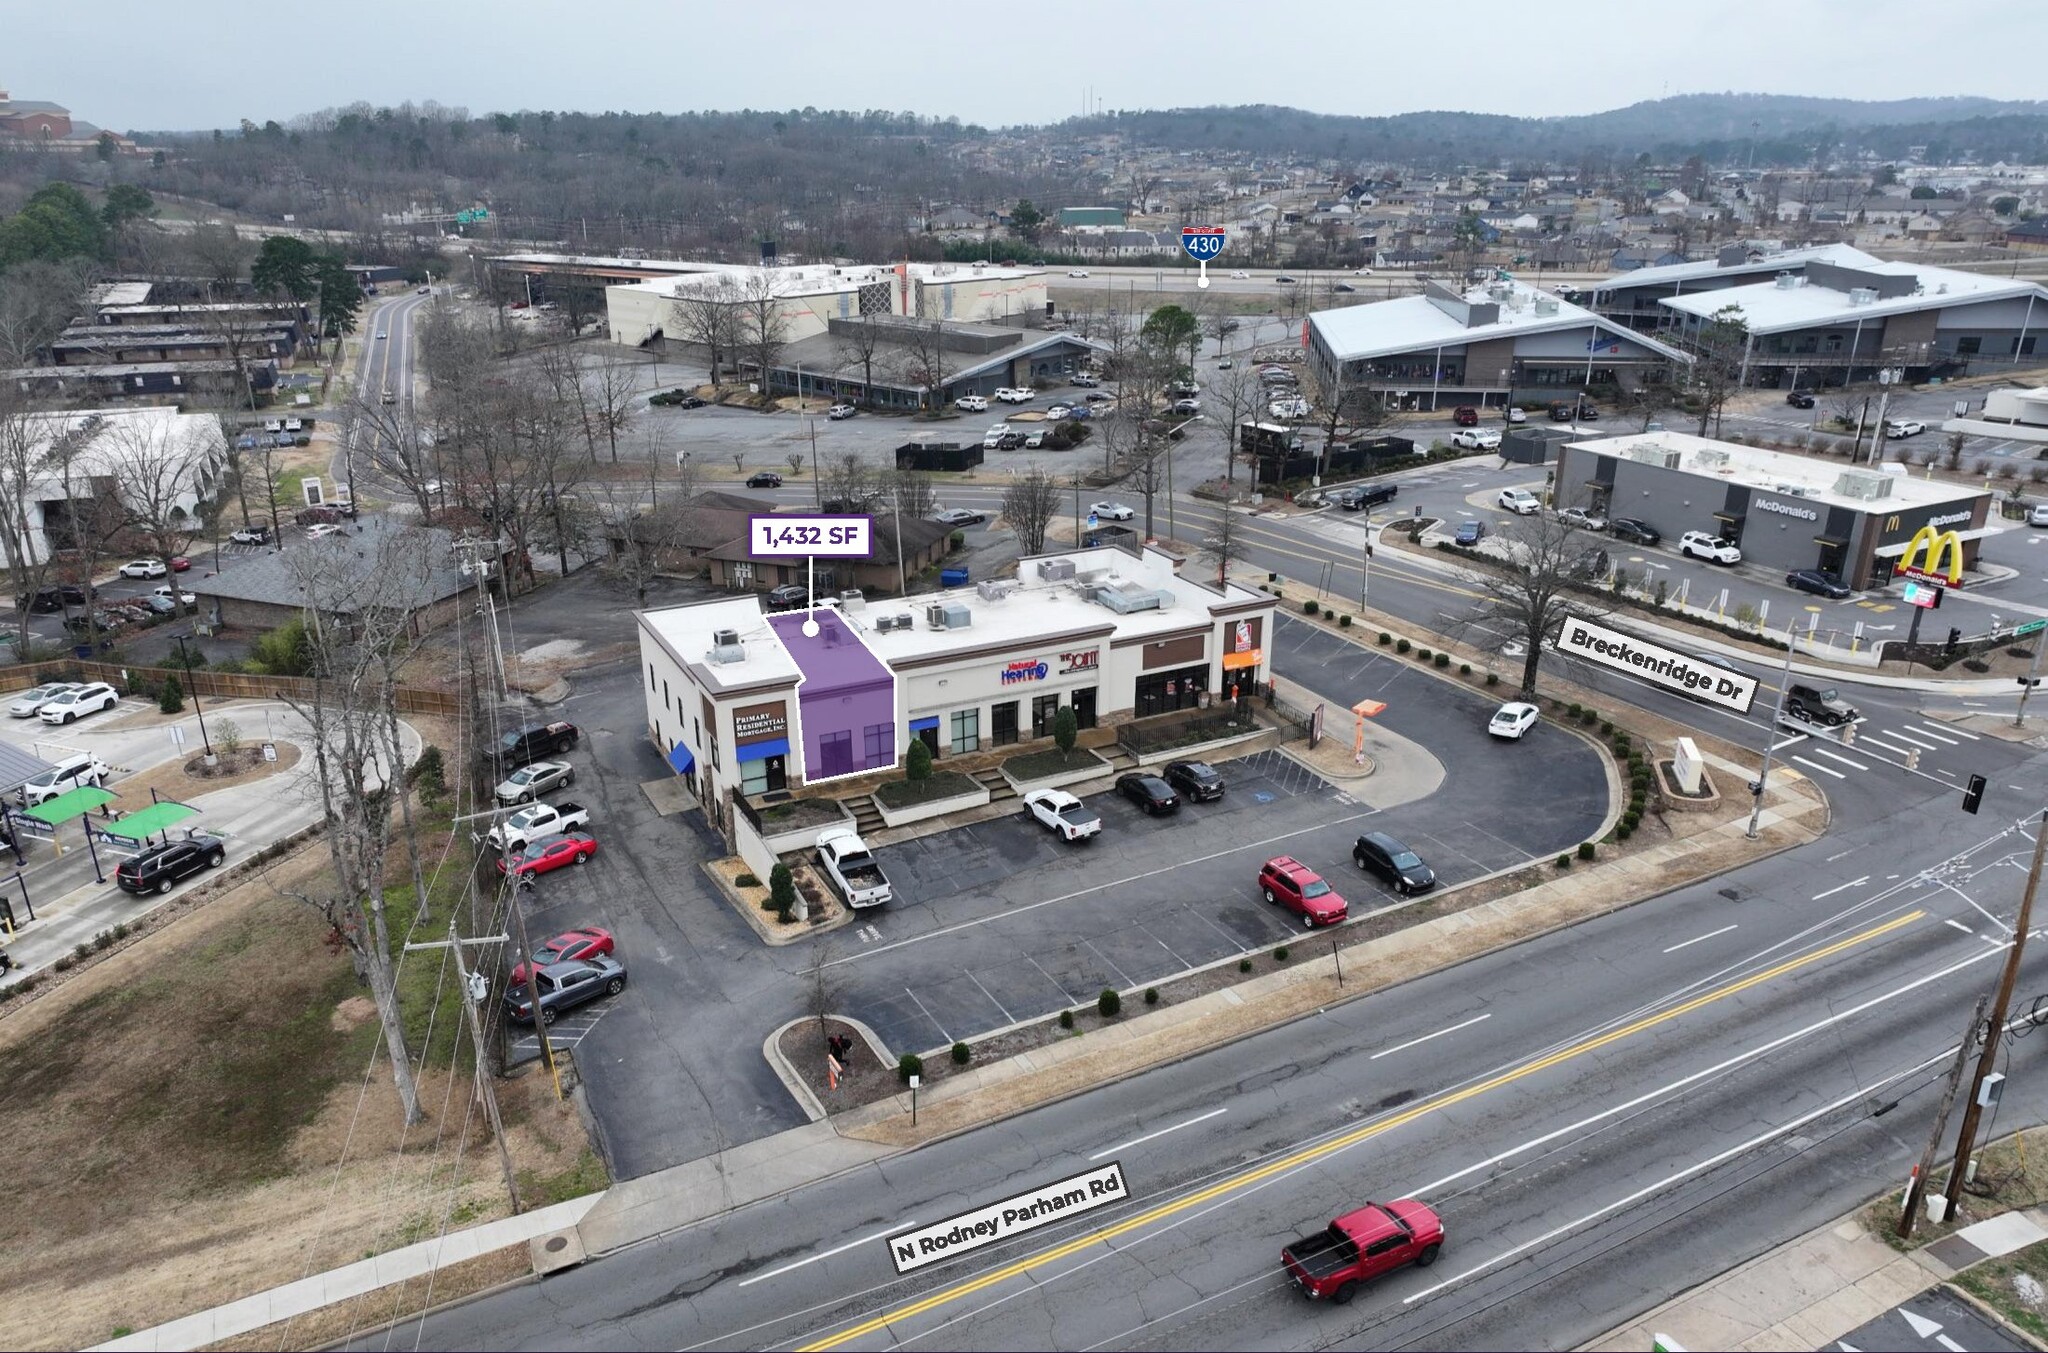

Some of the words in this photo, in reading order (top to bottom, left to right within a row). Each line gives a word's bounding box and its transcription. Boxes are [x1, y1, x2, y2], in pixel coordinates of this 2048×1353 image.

[1755, 498, 1817, 521] McDonald's
[1905, 570, 1947, 586] McDonald's
[736, 713, 770, 725] PRIMARY
[736, 718, 786, 732] RESIDENTIAL
